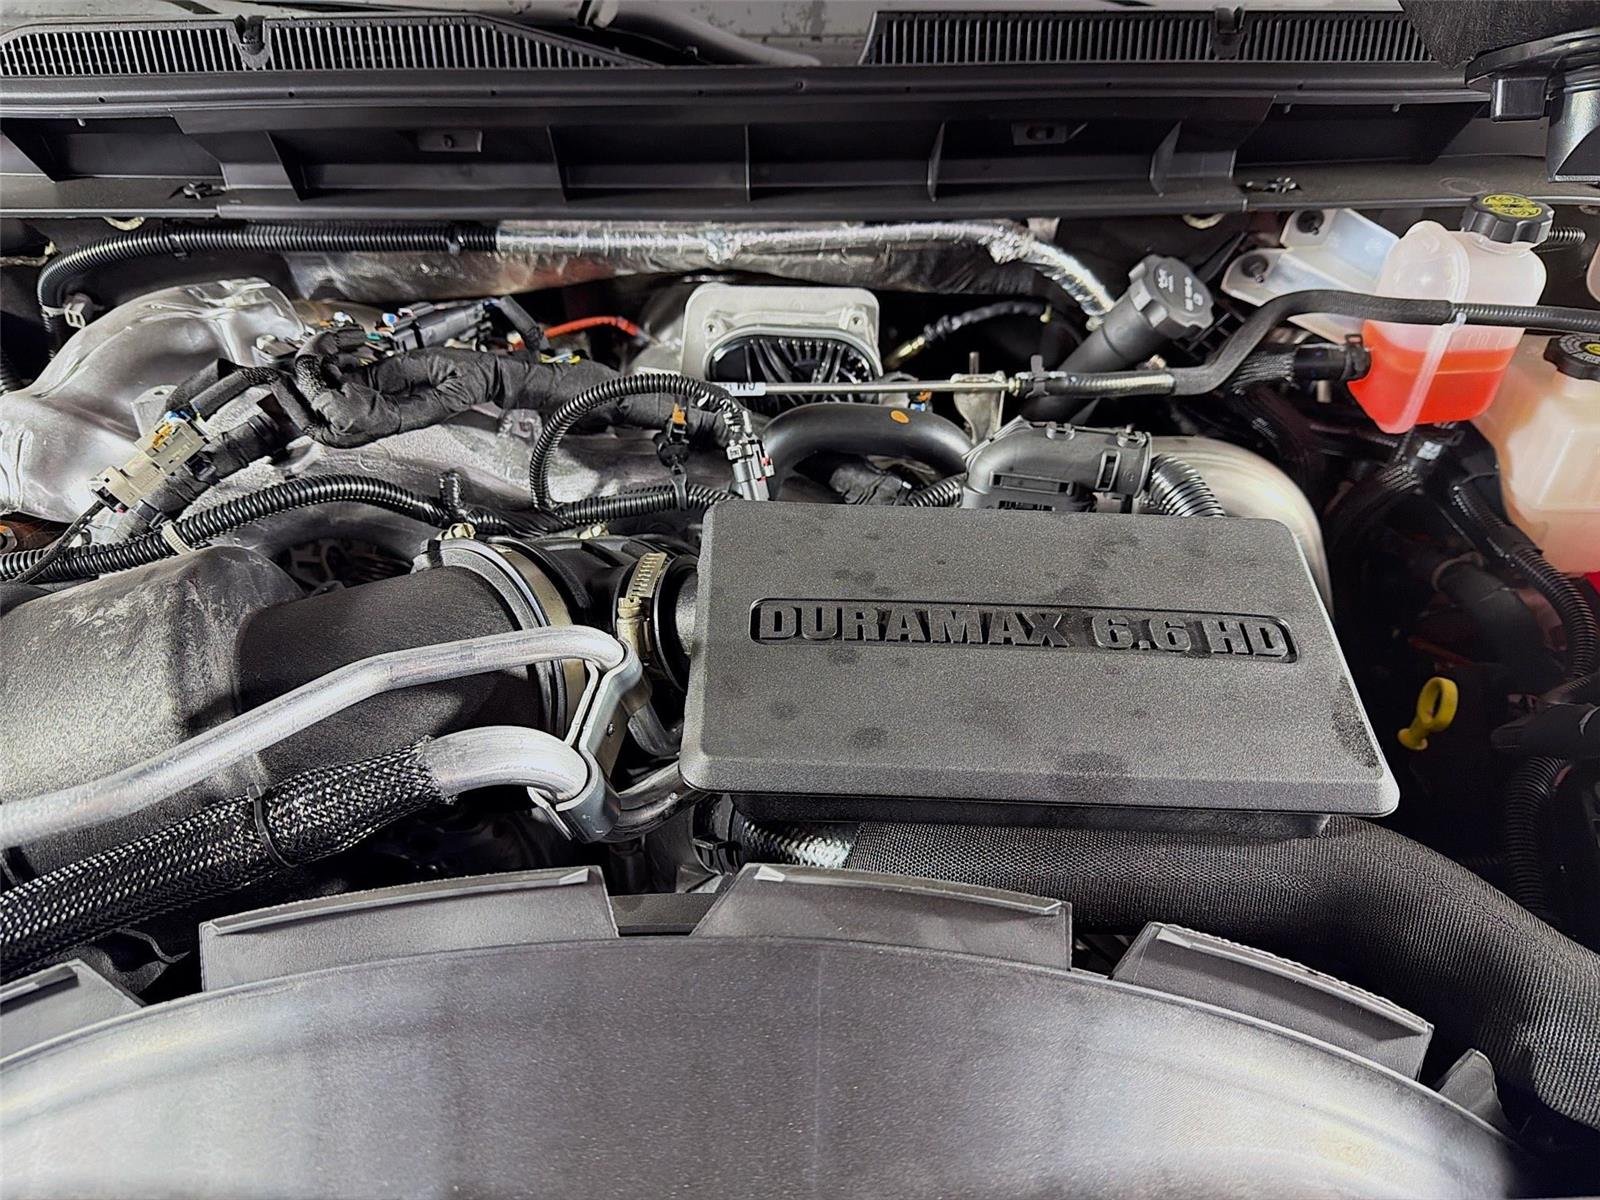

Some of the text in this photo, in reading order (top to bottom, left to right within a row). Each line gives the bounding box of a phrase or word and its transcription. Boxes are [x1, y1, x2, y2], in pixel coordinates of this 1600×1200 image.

[759, 604, 1289, 657] DURAMAX 6.6 HD
